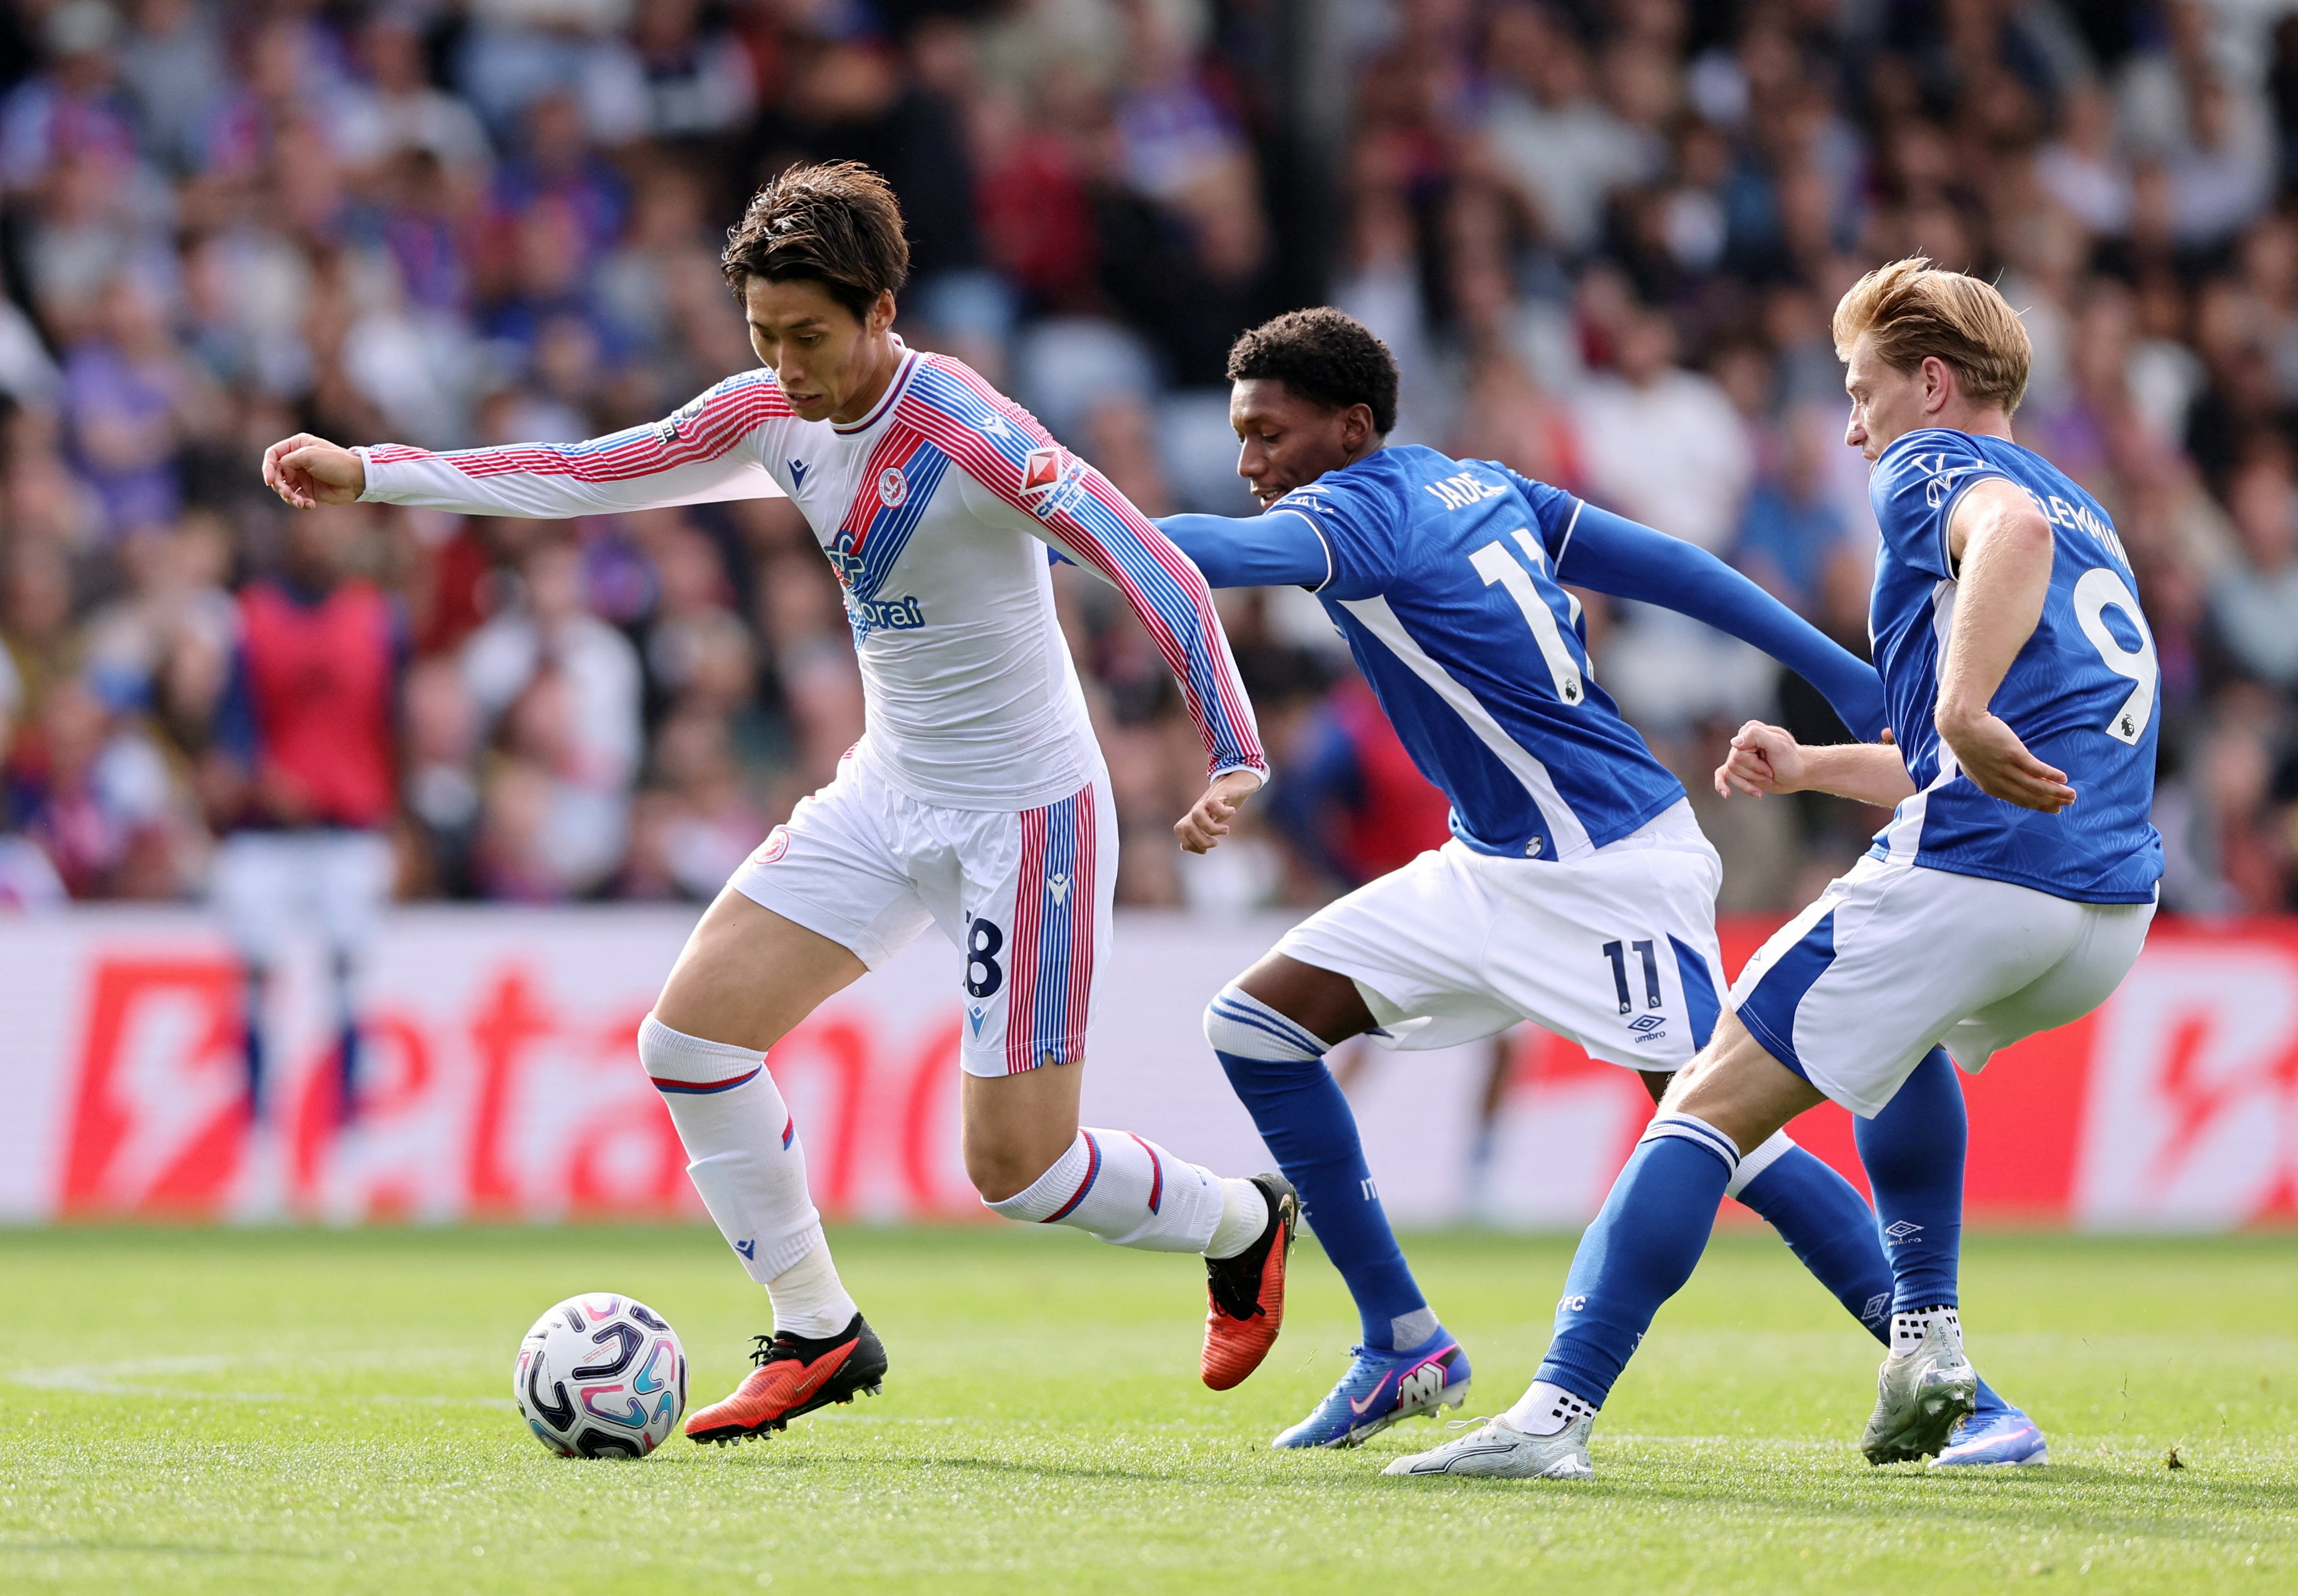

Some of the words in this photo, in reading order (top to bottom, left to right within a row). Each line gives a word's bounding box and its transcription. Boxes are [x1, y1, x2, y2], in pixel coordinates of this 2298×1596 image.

[1036, 464, 1084, 517] CHEXX
[1061, 485, 1082, 510] BET
[2072, 566, 2158, 747] 9
[962, 909, 1003, 998] 8
[1602, 939, 1663, 1015] 11
[1635, 1030, 1666, 1044] umbro
[1868, 1307, 1892, 1329] umbr
[1938, 1326, 1953, 1357] ULTRA
[833, 1359, 852, 1379] PHANTOM
